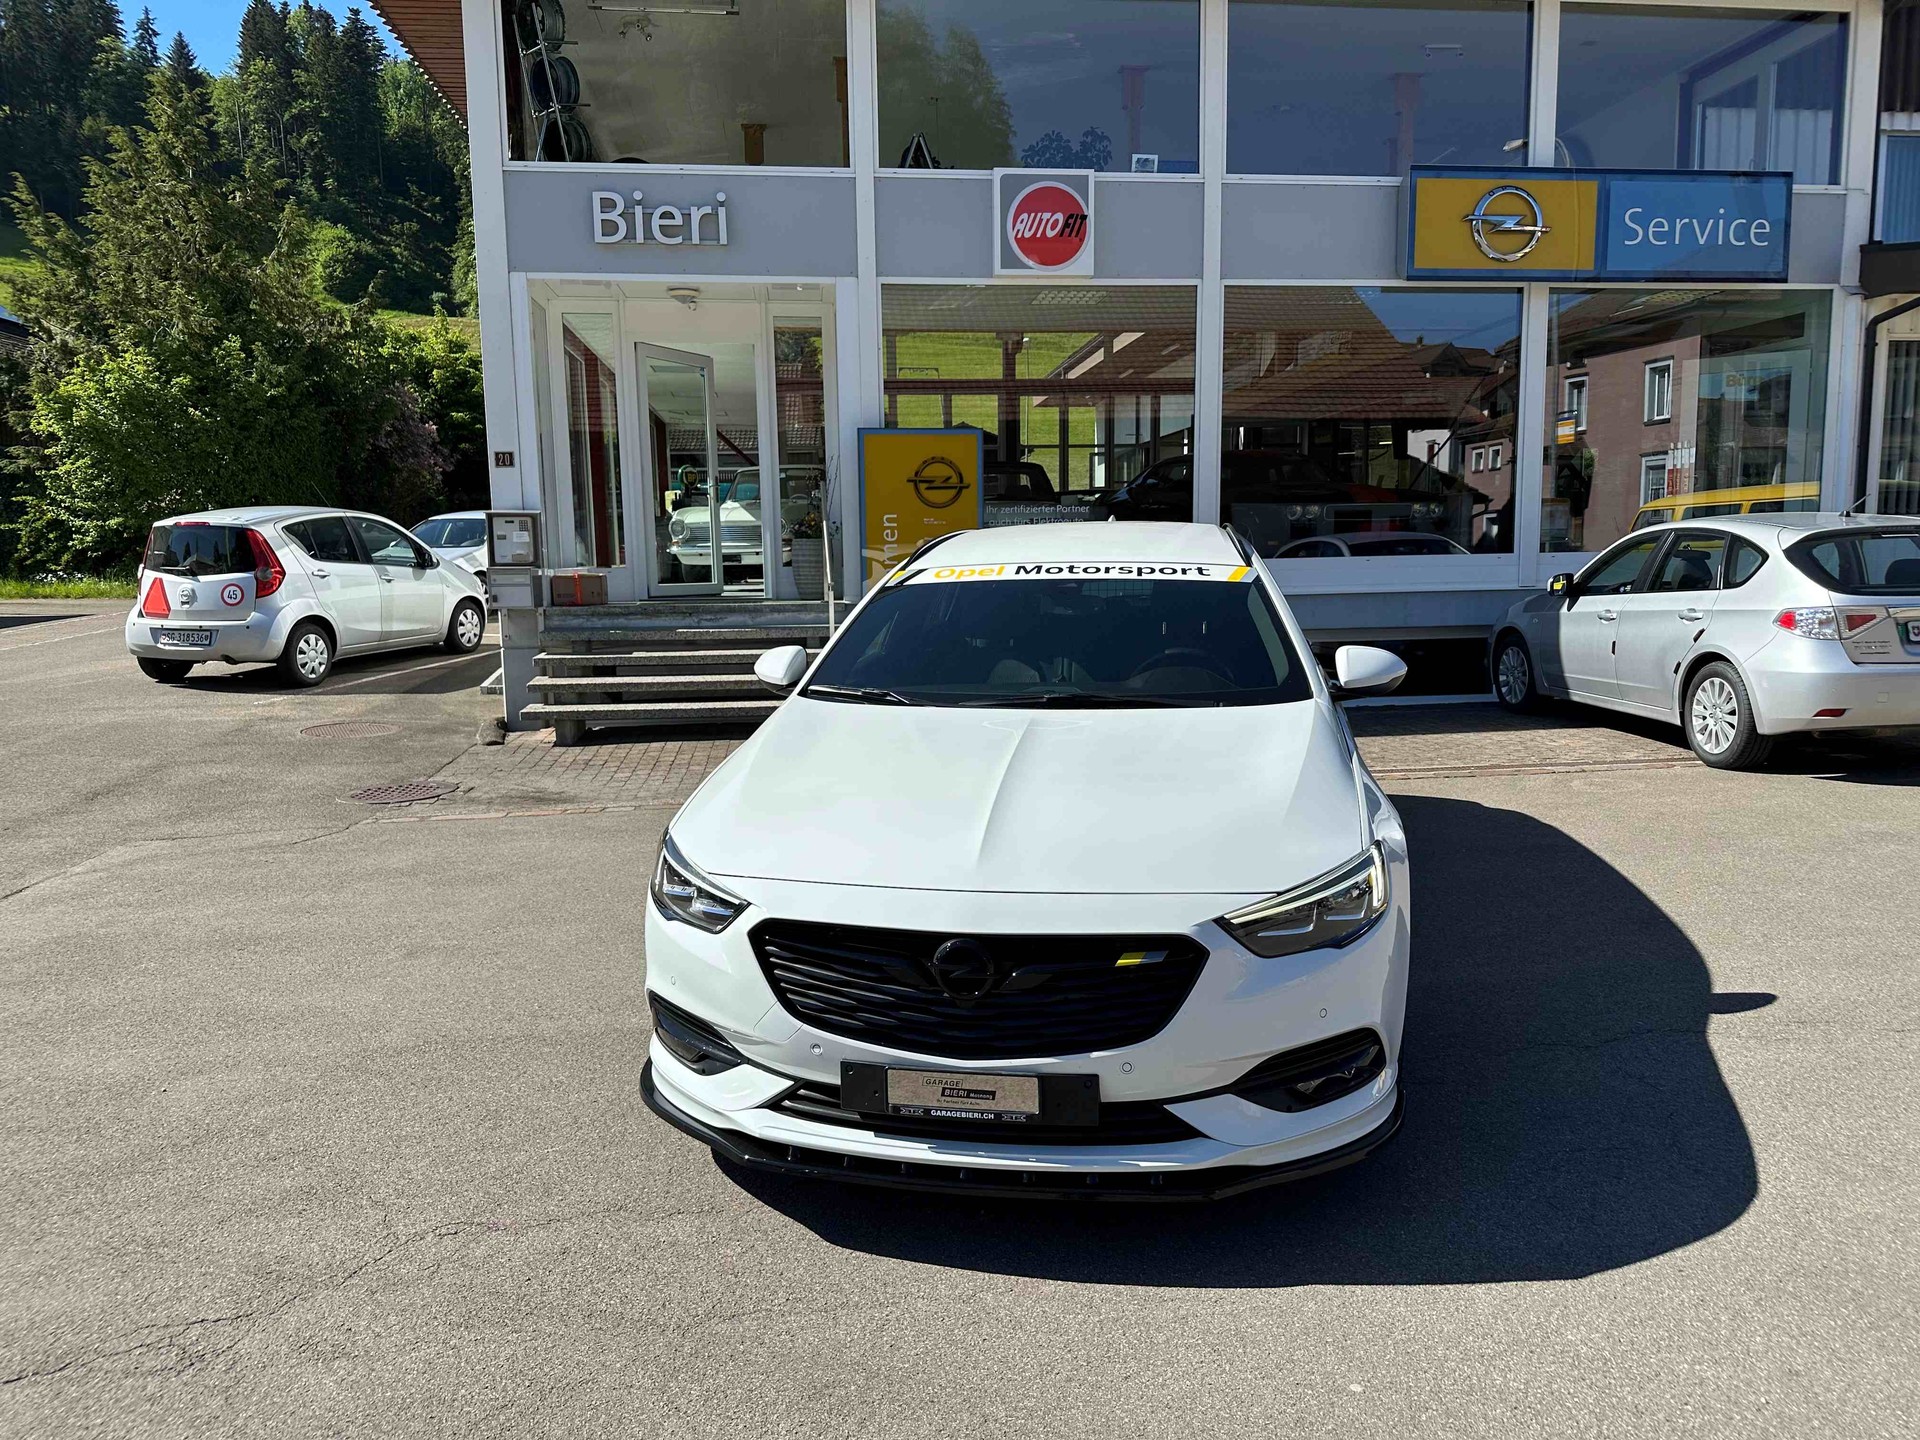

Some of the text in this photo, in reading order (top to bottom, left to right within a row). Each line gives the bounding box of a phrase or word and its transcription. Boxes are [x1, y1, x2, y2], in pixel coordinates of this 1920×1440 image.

[592, 190, 728, 245] Bieri
[1012, 211, 1089, 239] AUTOFIT
[1624, 207, 1771, 247] Service
[498, 453, 510, 466] 20
[986, 504, 1090, 514] Ihr zertifizierter Partner
[988, 517, 1012, 527] auch
[933, 564, 1211, 581] Opel Motorsport
[227, 589, 238, 601] 45
[925, 1078, 961, 1088] GARAGE
[944, 1089, 967, 1098] BIERI
[930, 1109, 994, 1120] GARAGEBIERI.CH
